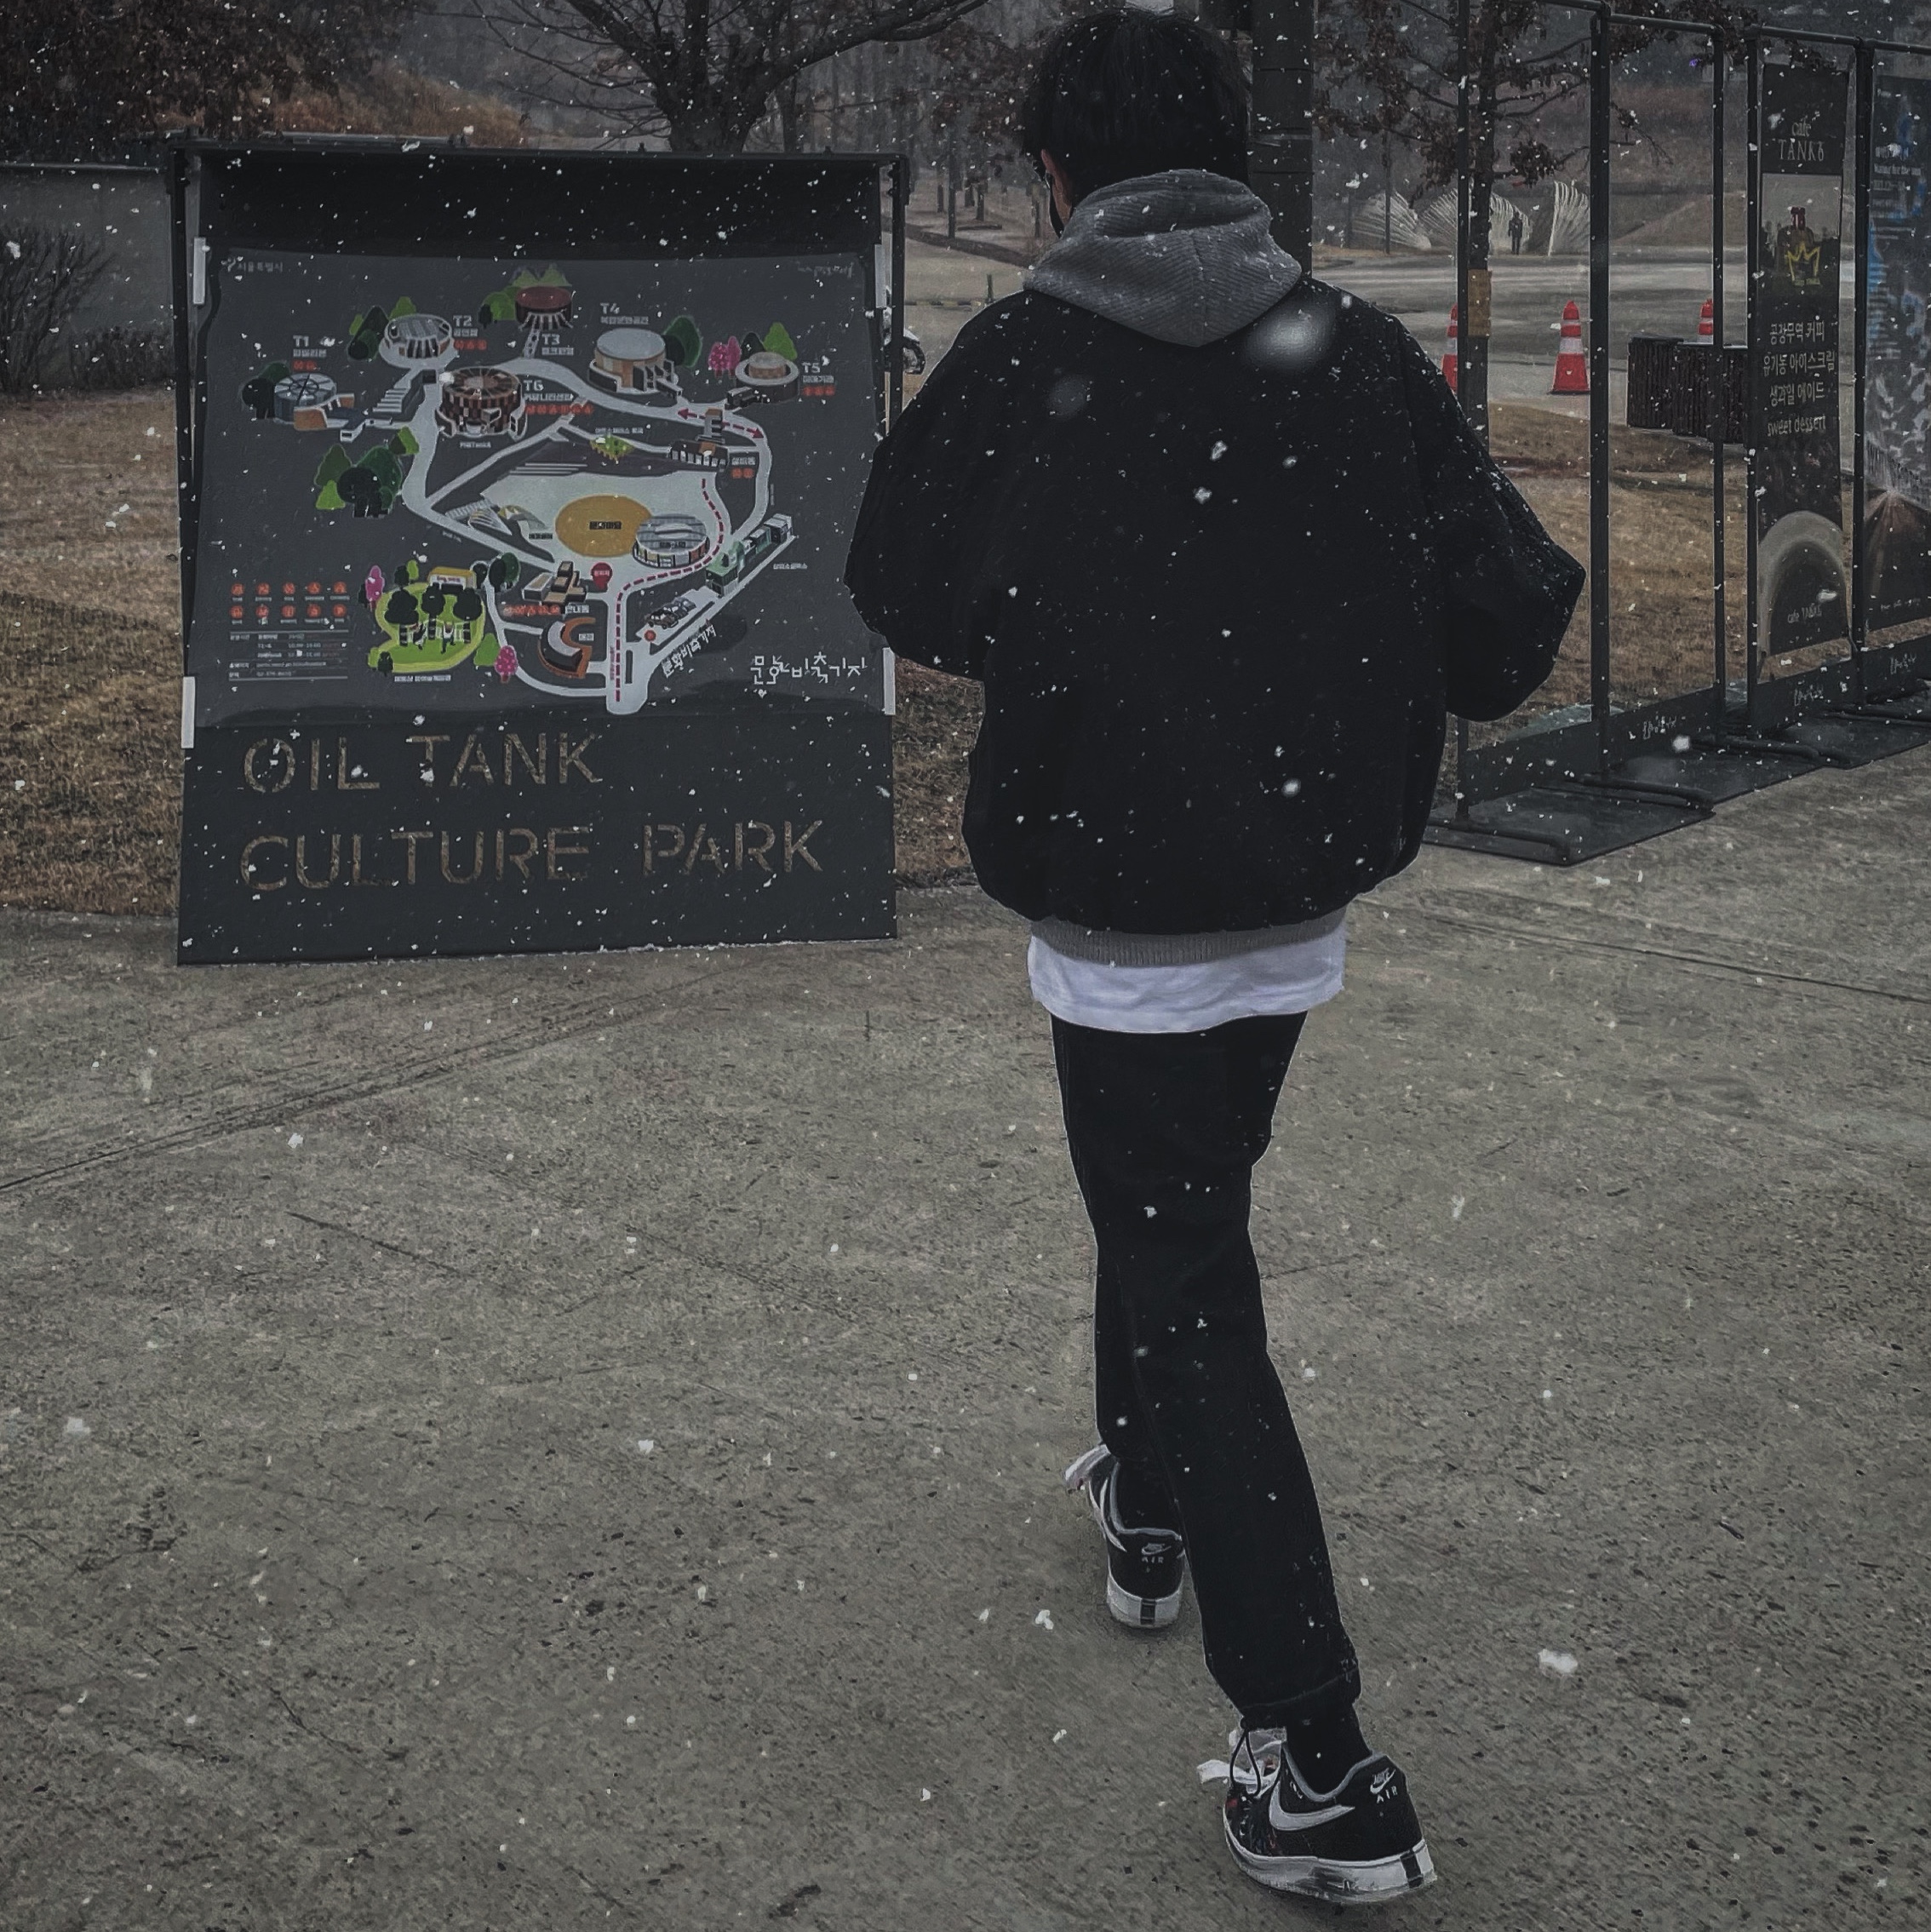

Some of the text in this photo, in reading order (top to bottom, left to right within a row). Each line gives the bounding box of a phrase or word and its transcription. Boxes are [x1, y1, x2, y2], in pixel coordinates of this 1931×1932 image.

[1791, 118, 1811, 137] cafe
[600, 302, 621, 314] T4
[453, 315, 473, 327] T2
[541, 333, 560, 345] T3
[1805, 320, 1825, 342] 커피
[293, 335, 309, 347] T1
[802, 362, 821, 373] T5
[1789, 350, 1835, 373] 아이스크림
[524, 381, 544, 392] T6
[1797, 381, 1825, 403] 에이드
[750, 651, 868, 685] 문화비축기지
[243, 731, 602, 794] OIL TANK
[239, 819, 823, 891] CULTURE PARK
